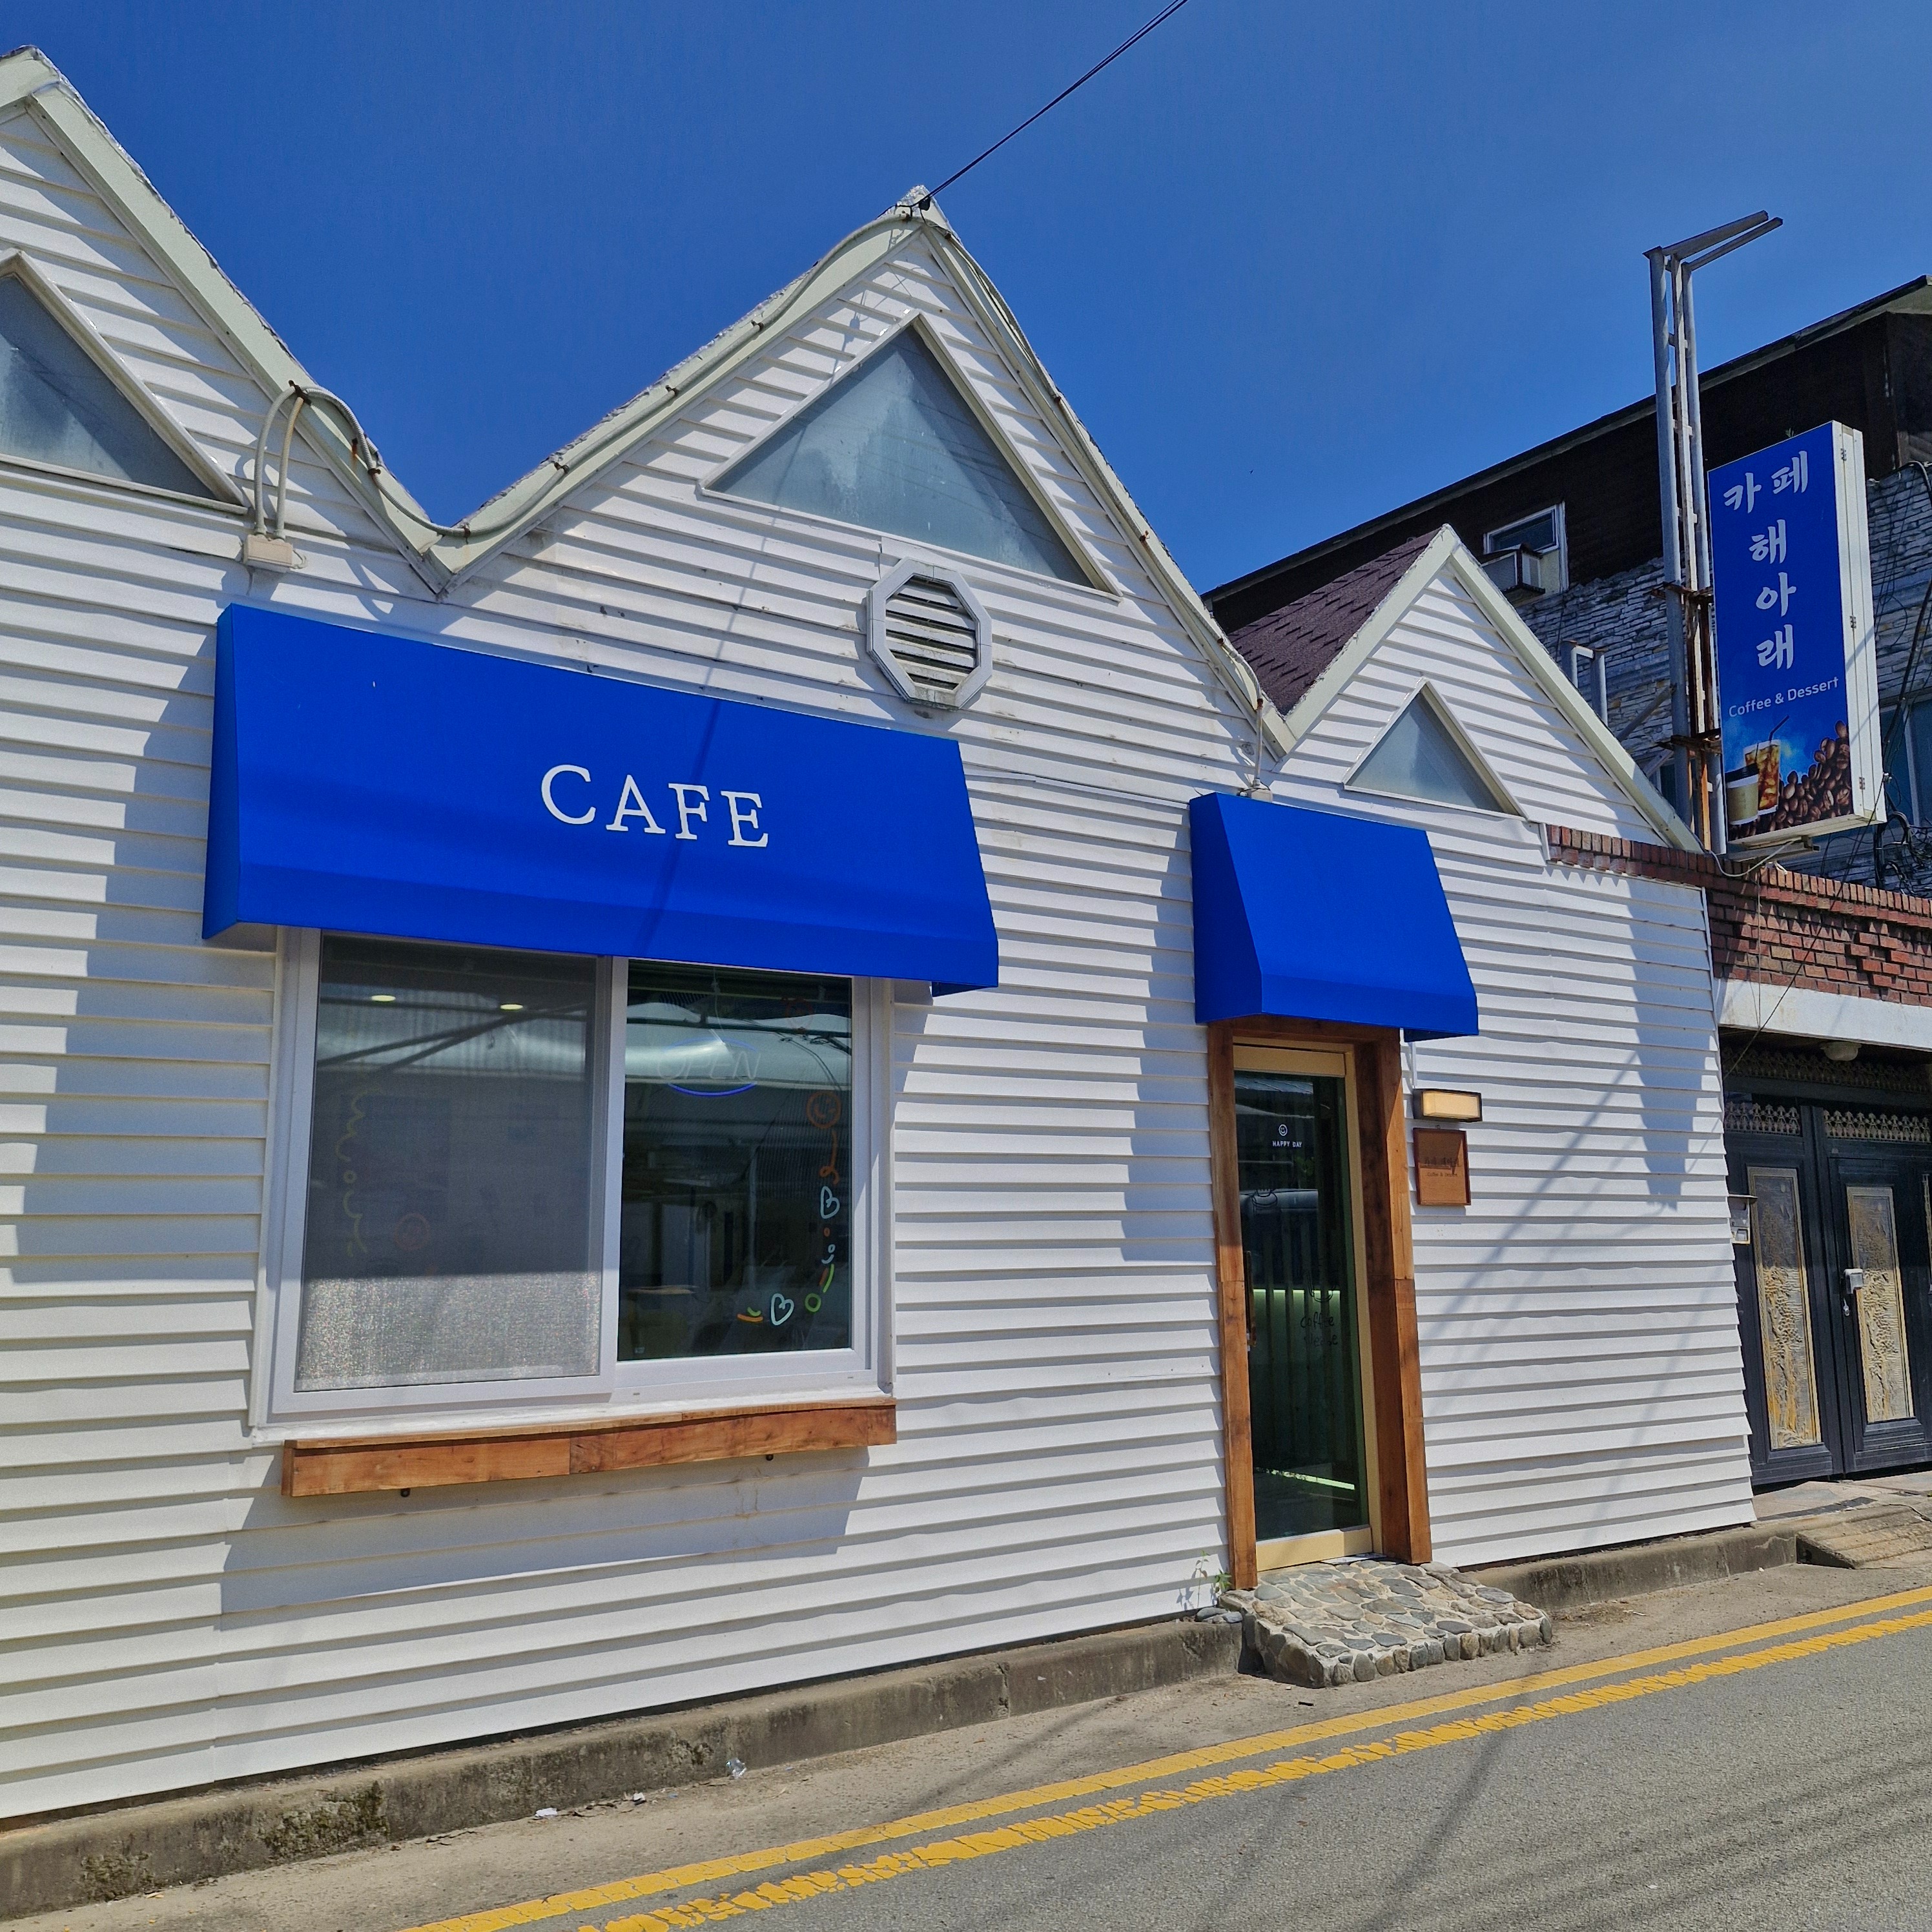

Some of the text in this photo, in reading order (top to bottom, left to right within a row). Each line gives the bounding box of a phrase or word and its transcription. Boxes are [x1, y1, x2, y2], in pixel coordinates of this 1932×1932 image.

[1723, 451, 1809, 513] 카페
[1749, 519, 1796, 670] 해아래
[1729, 676, 1839, 717] Coffee & Dessert
[541, 764, 769, 847] CAFE
[656, 1051, 762, 1080] OPEN
